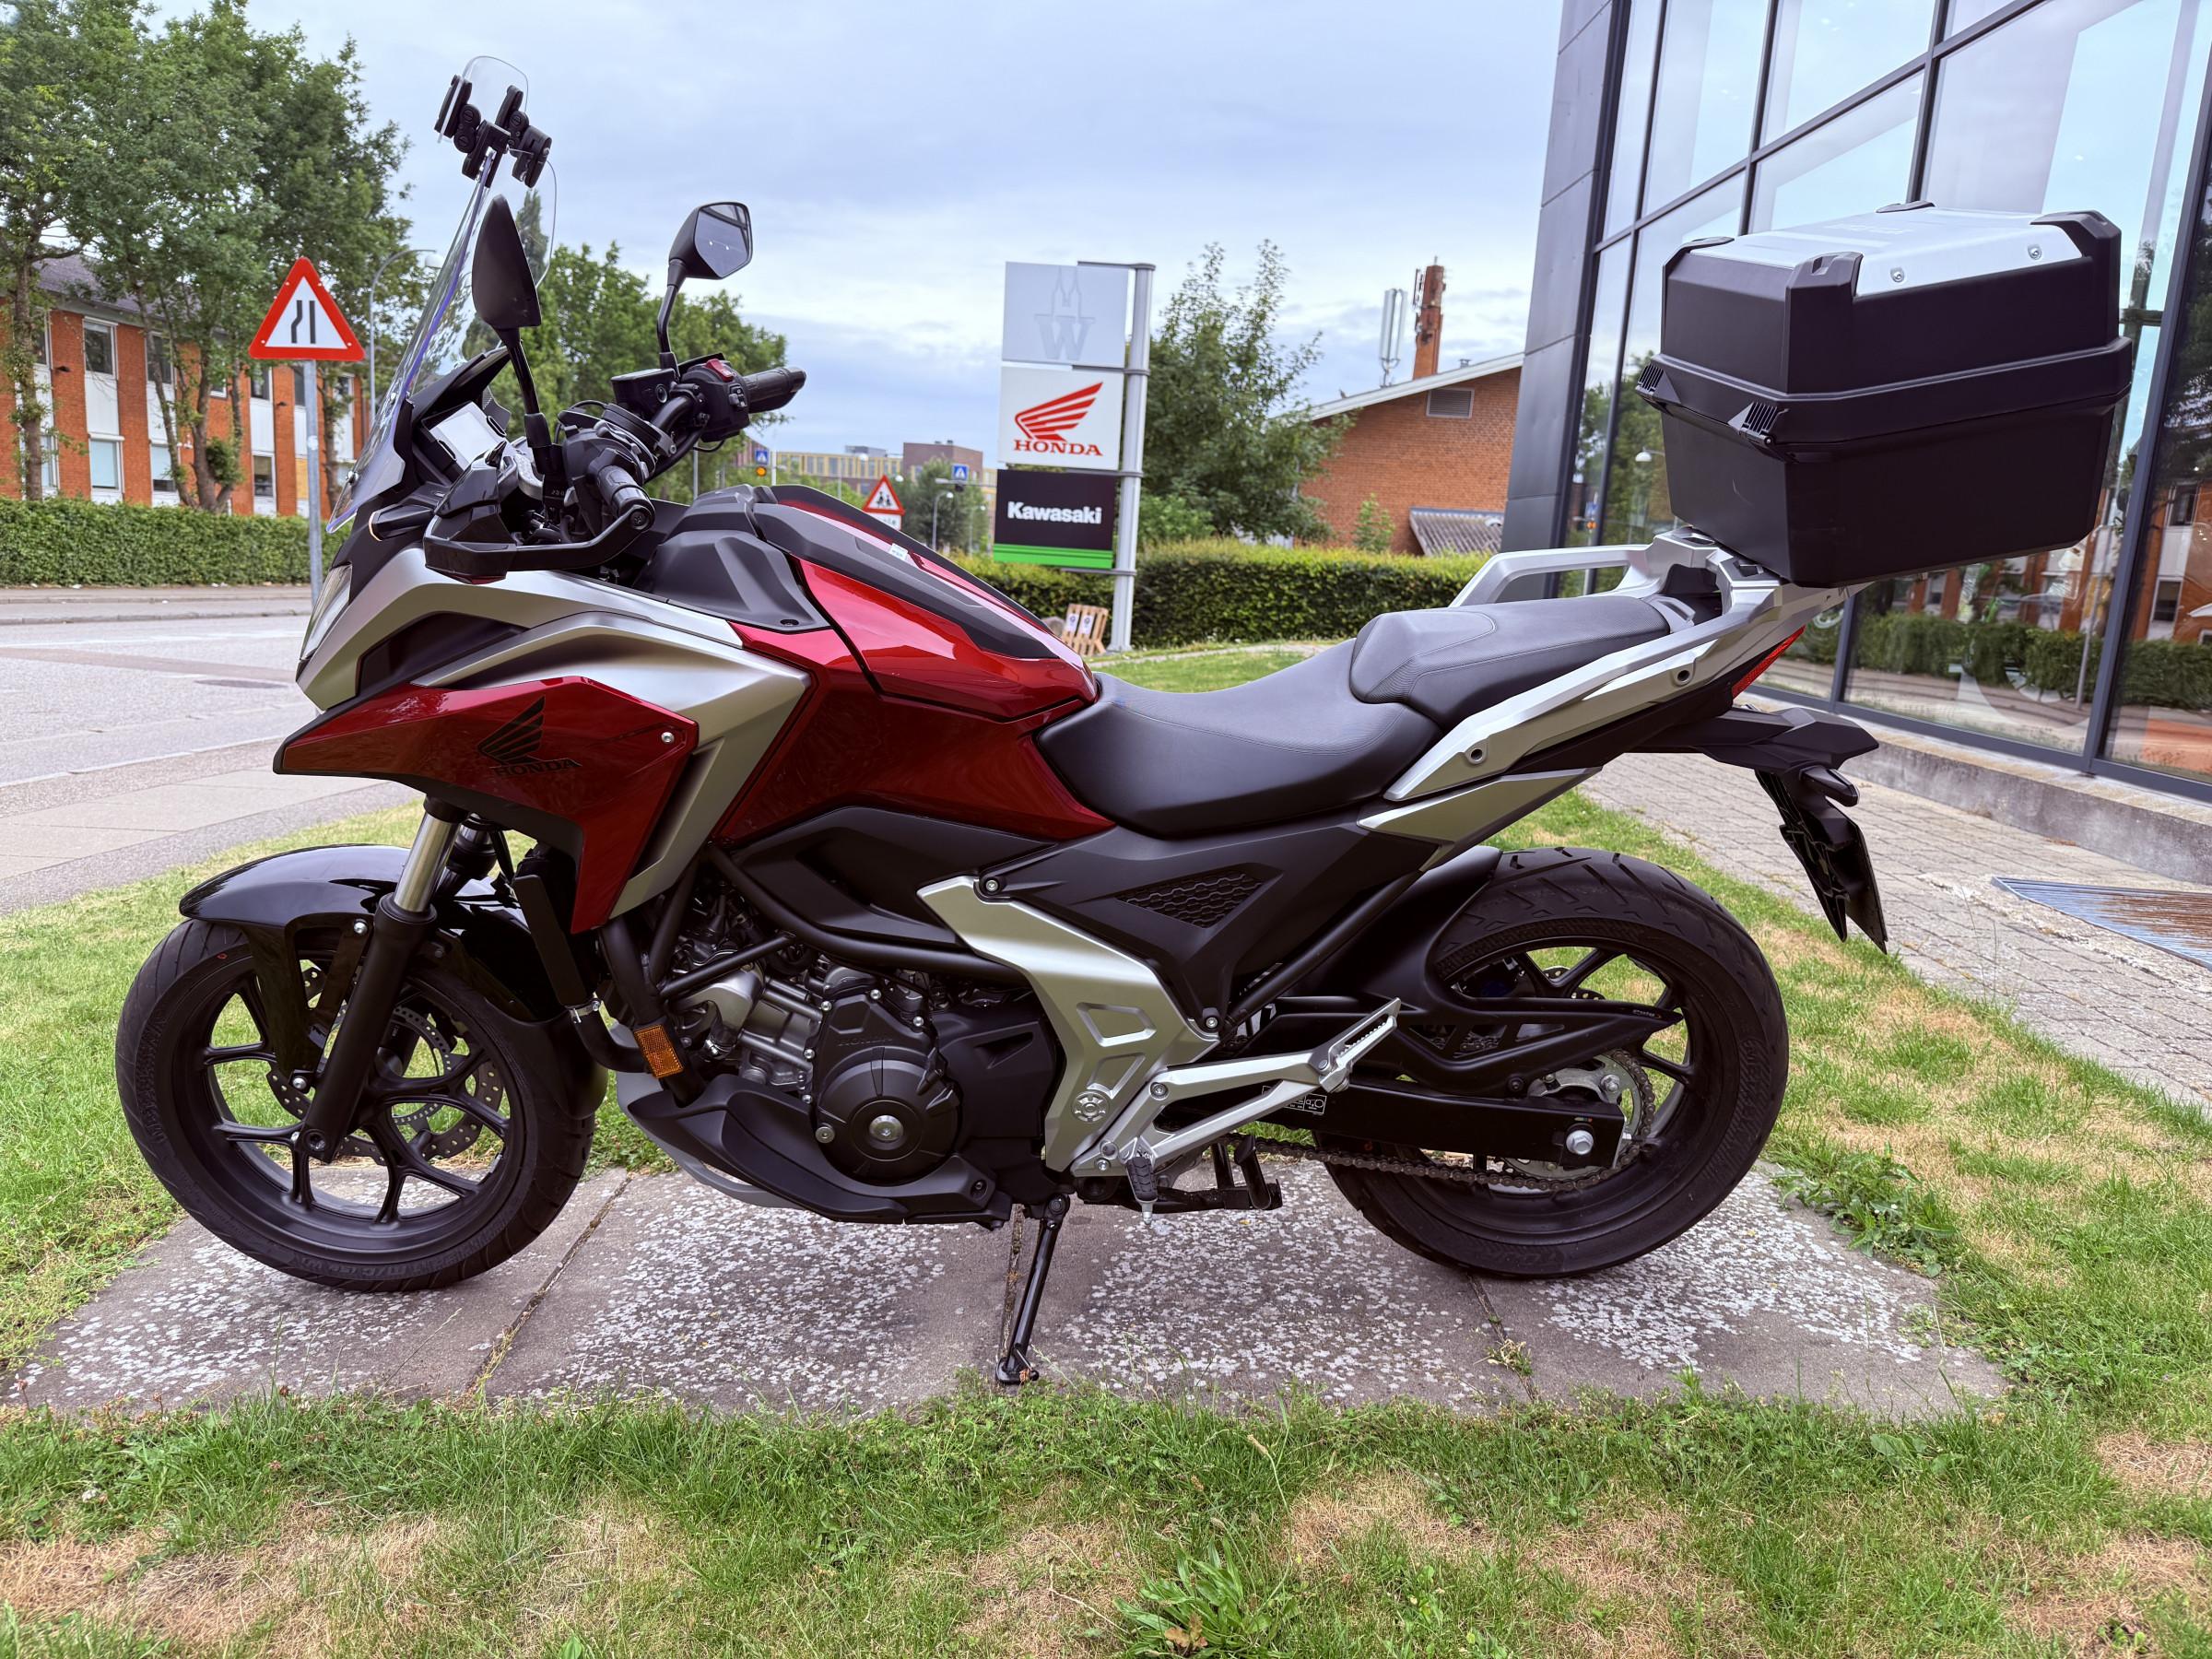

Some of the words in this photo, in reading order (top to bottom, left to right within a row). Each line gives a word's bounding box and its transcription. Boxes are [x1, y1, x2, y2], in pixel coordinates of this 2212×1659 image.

[1014, 440, 1103, 456] HONDA
[1007, 501, 1102, 524] Kawasaki
[490, 758, 582, 776] HONDA
